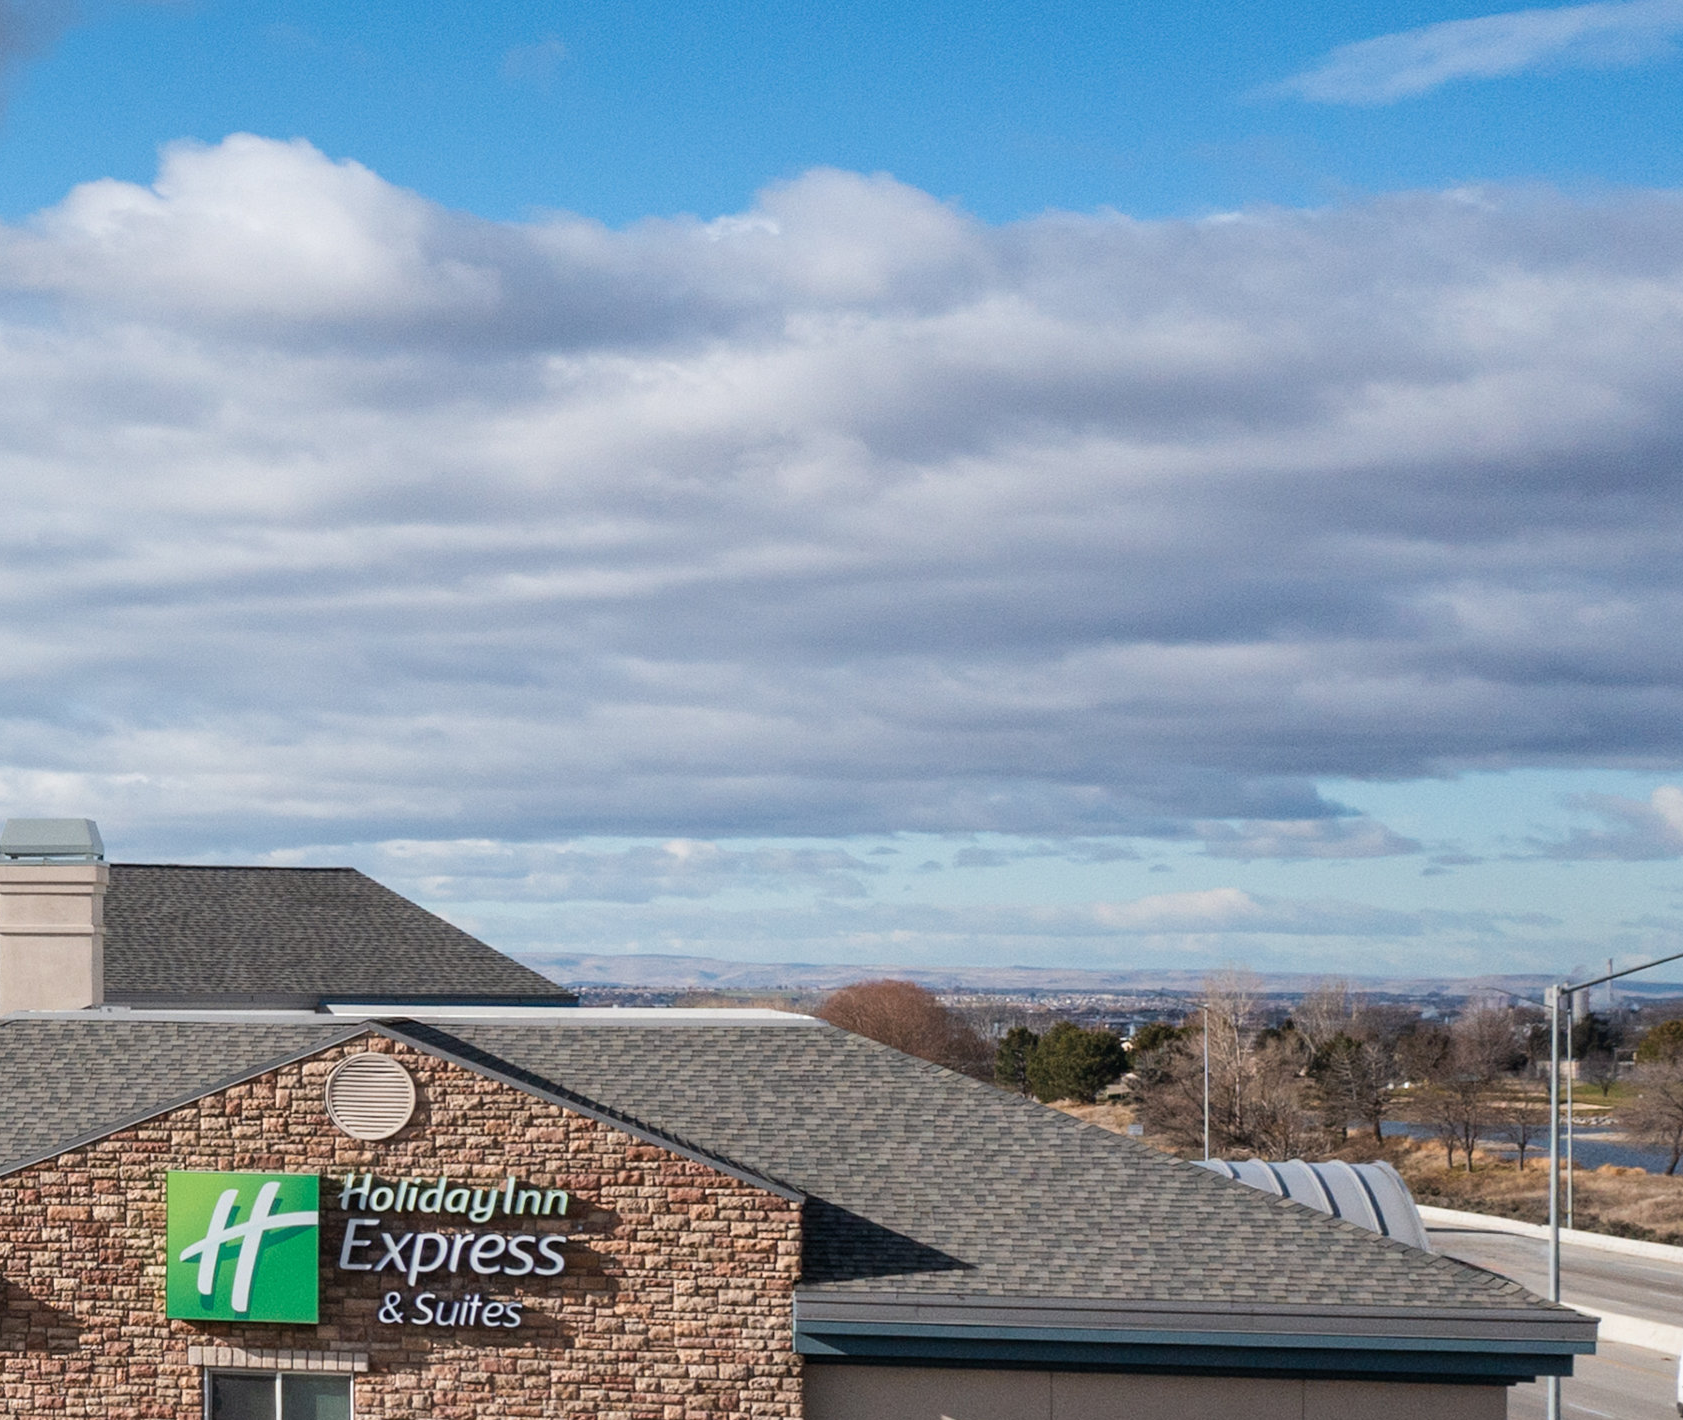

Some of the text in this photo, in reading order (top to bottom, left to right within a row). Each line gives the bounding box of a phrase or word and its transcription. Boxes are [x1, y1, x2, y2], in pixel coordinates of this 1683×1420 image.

[338, 1172, 568, 1223] Holiday Inn
[339, 1218, 567, 1287] Express
[377, 1291, 522, 1328] & Suites
